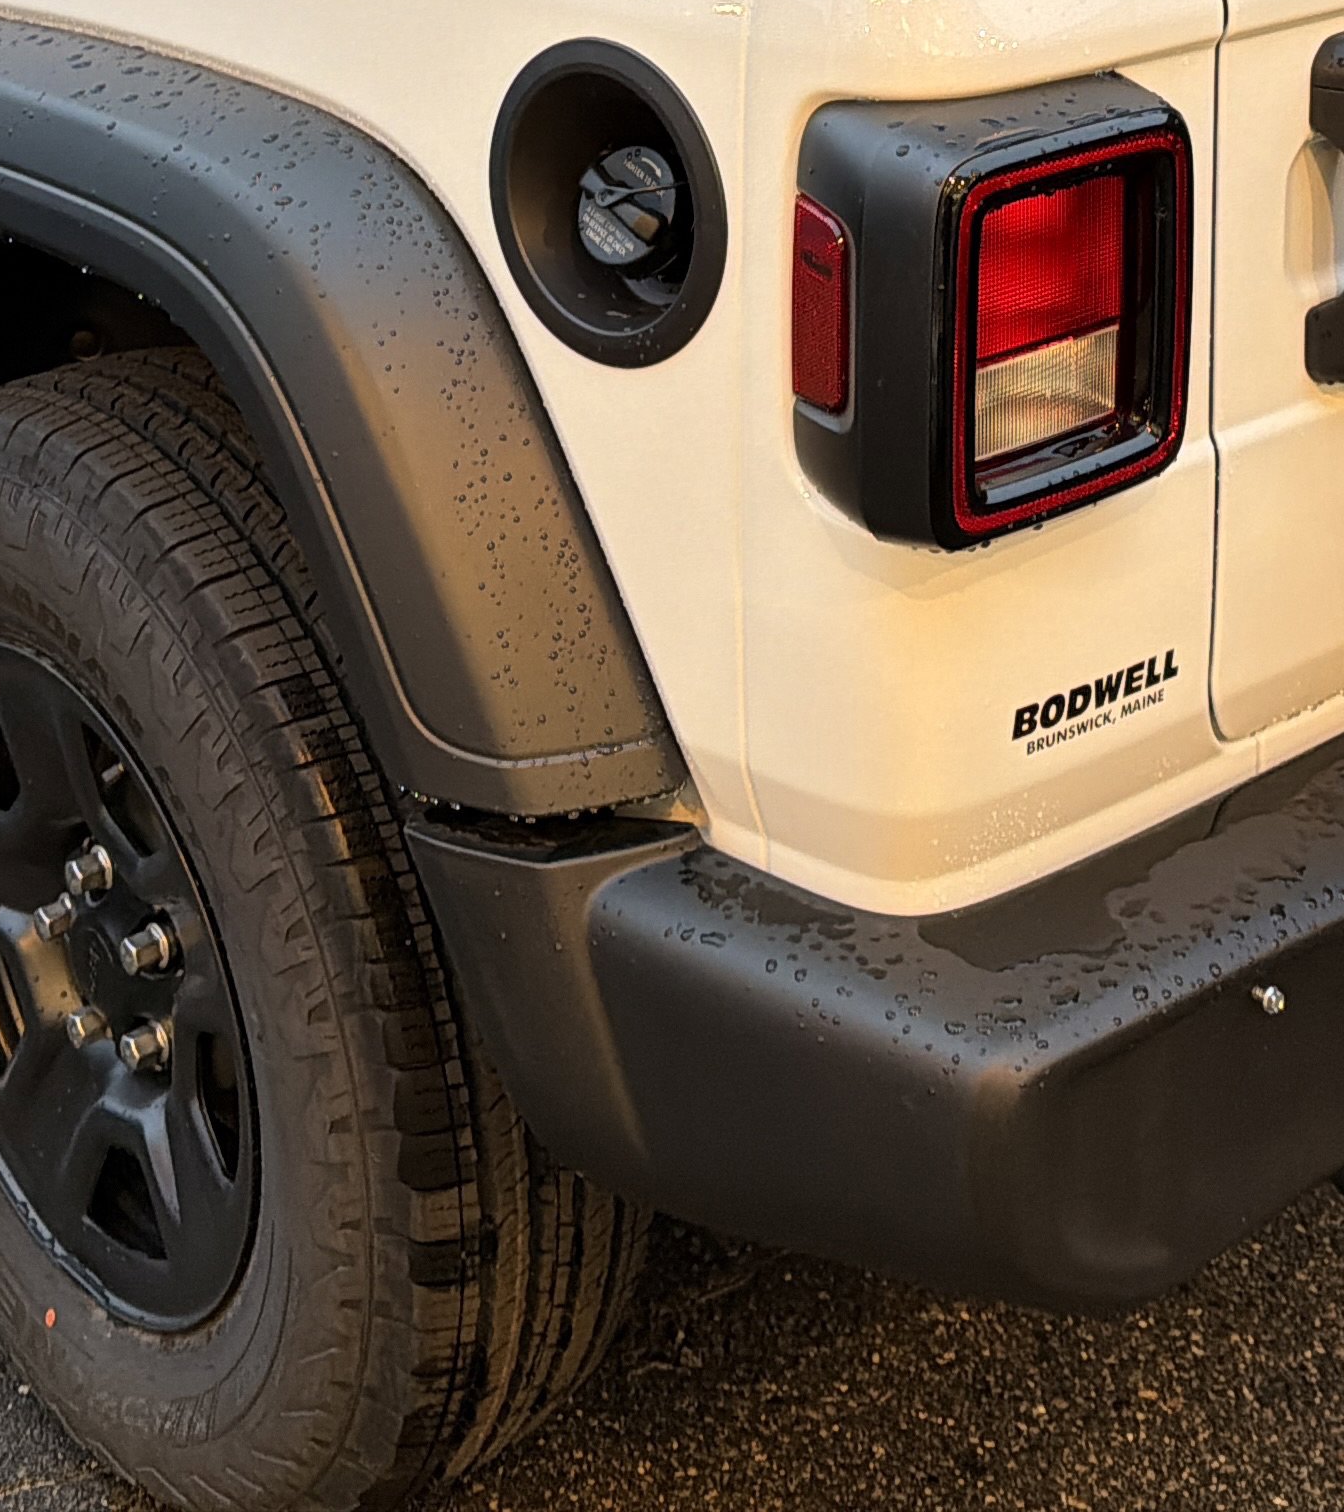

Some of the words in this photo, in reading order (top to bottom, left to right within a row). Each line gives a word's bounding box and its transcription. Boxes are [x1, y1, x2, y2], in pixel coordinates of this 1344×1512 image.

[1011, 648, 1179, 741] BODWELL
[1026, 710, 1117, 756] BRUNSWICK,
[1120, 688, 1165, 719] MAINE
